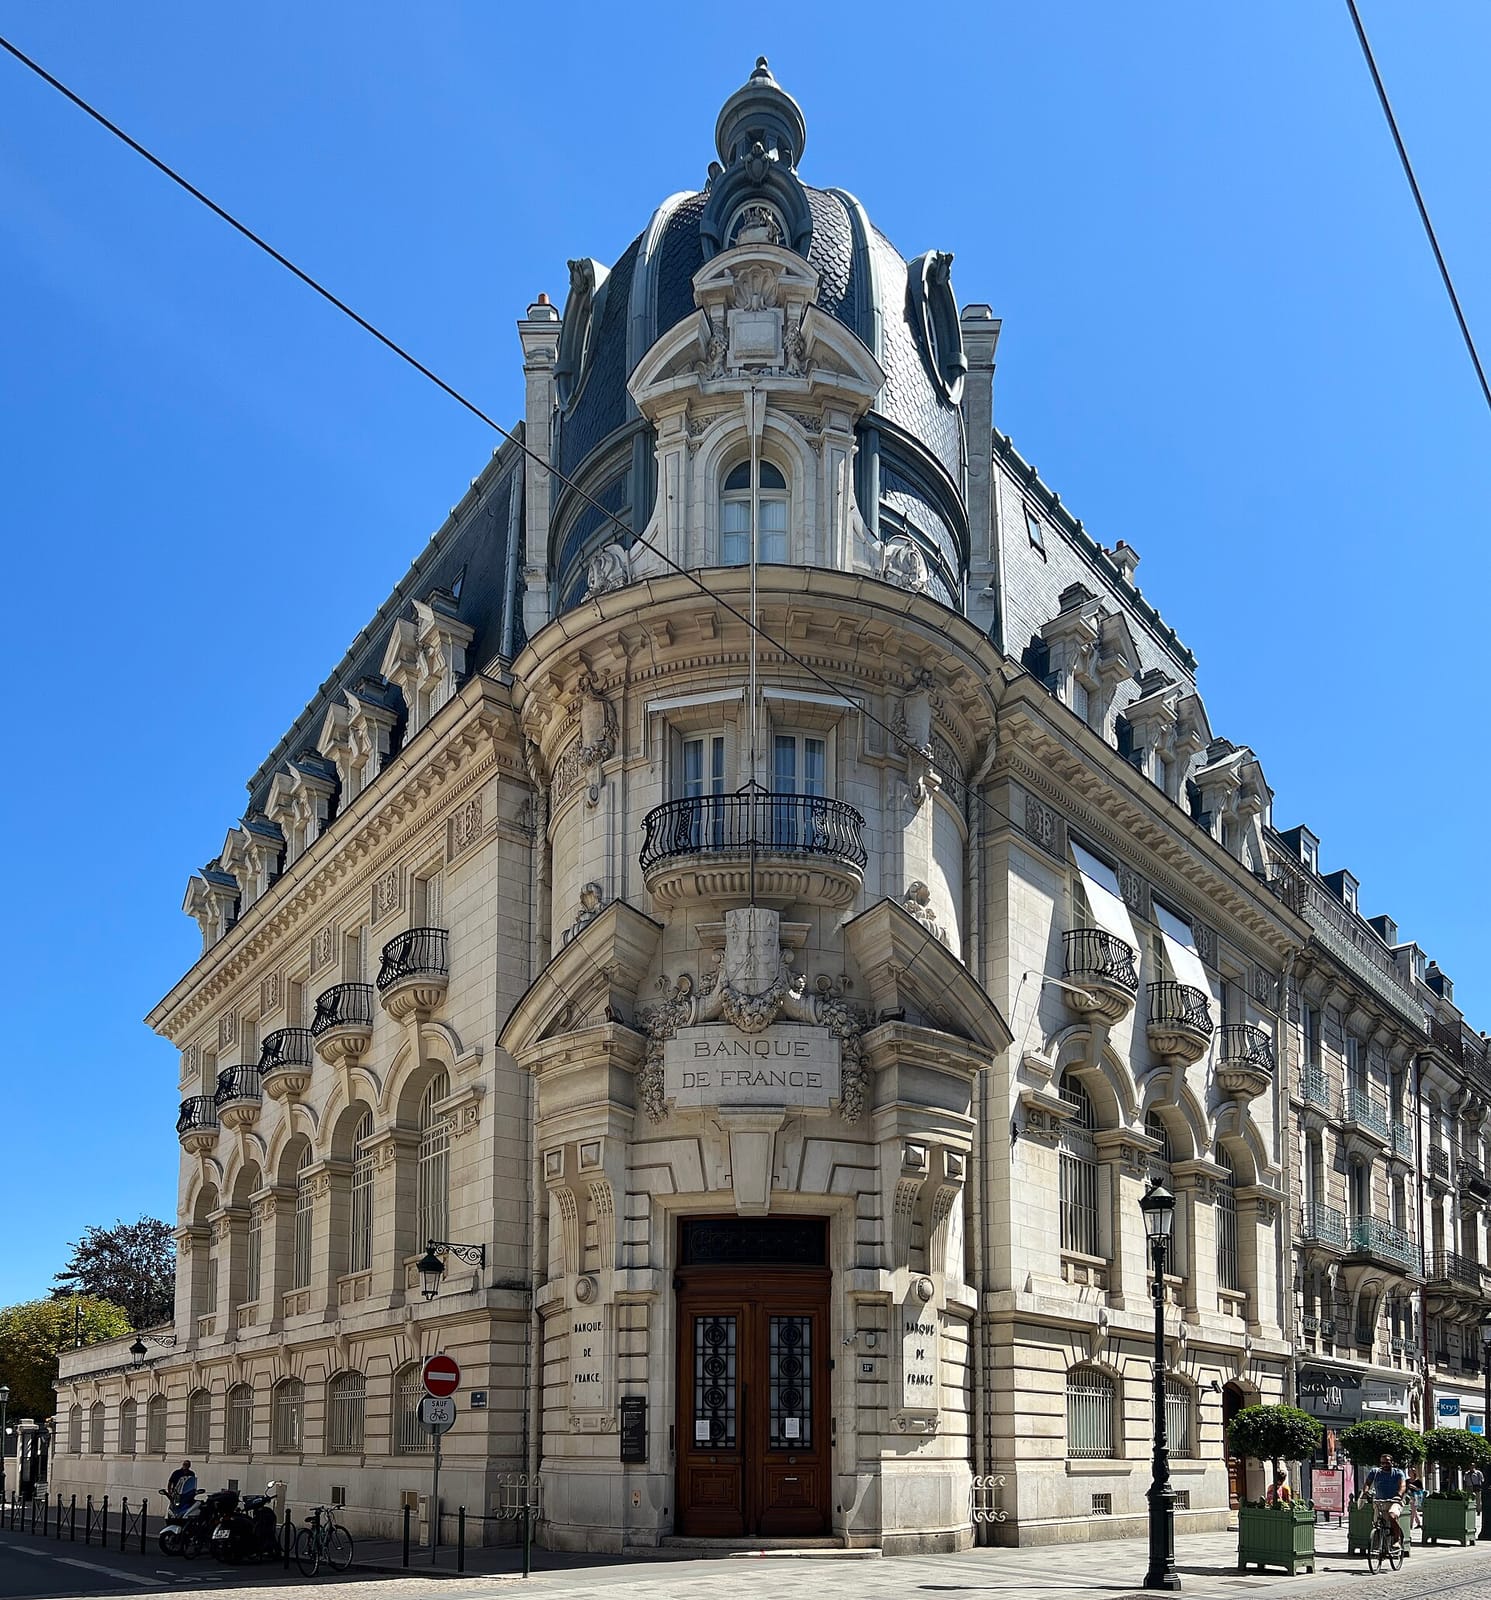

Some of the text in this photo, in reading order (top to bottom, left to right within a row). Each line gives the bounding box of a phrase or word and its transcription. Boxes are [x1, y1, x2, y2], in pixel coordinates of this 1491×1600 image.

[694, 1040, 811, 1059] BANQUE
[682, 1070, 823, 1088] DE FRANCE
[574, 1321, 602, 1333] BANQUE
[906, 1322, 934, 1336] BANQUE
[583, 1347, 592, 1357] DE
[916, 1349, 925, 1360] DE
[574, 1372, 600, 1383] FRANCE
[908, 1373, 933, 1386] FRANCE
[431, 1400, 448, 1408] SAUF
